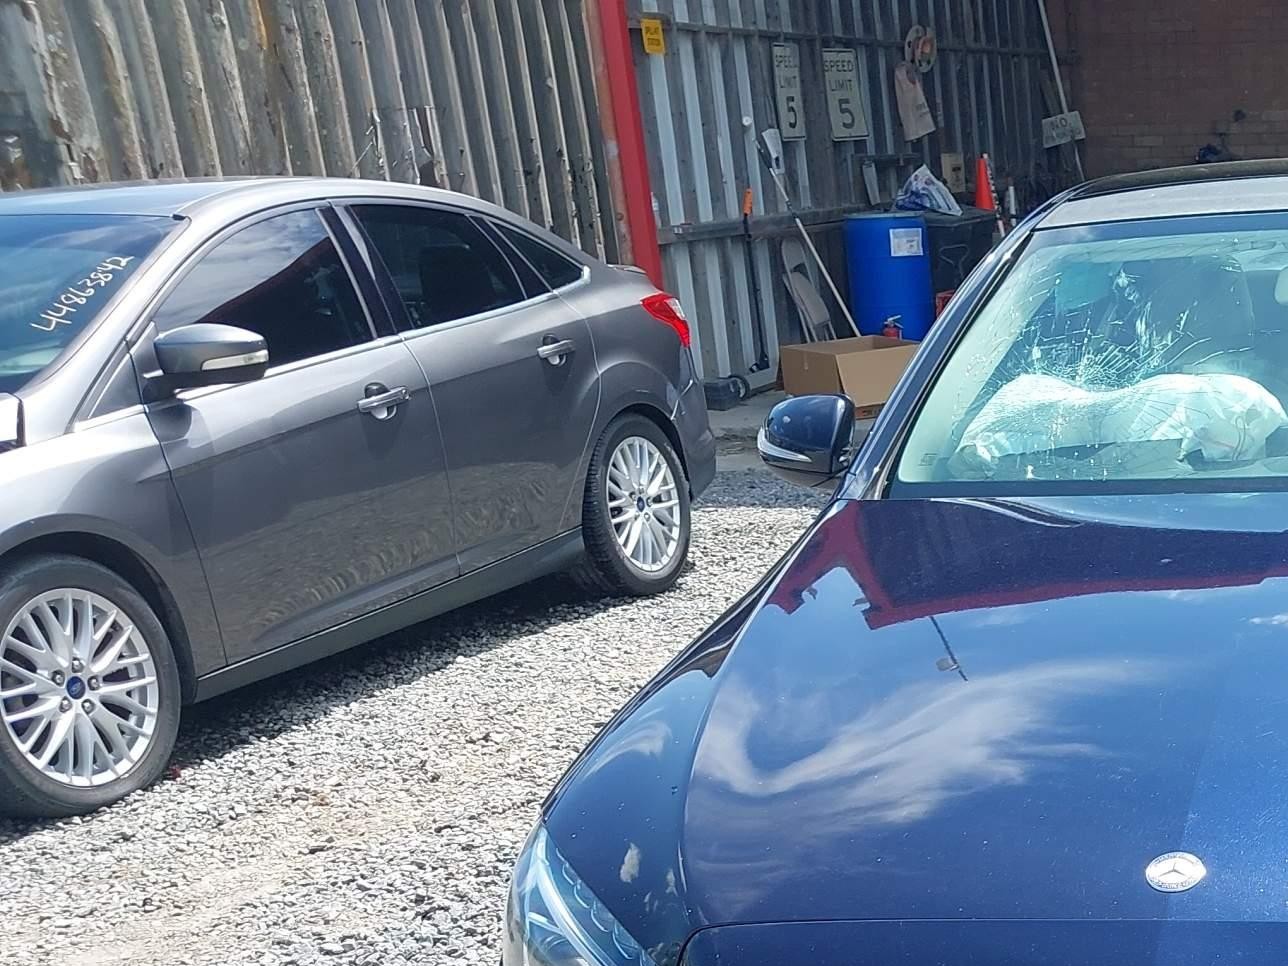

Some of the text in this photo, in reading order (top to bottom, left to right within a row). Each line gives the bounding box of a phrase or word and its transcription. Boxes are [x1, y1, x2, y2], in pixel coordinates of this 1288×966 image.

[823, 60, 854, 72] SPEED
[829, 79, 853, 92] LIMIT
[785, 95, 798, 129] 5
[837, 98, 855, 129] 5
[29, 255, 135, 331] 44863842
